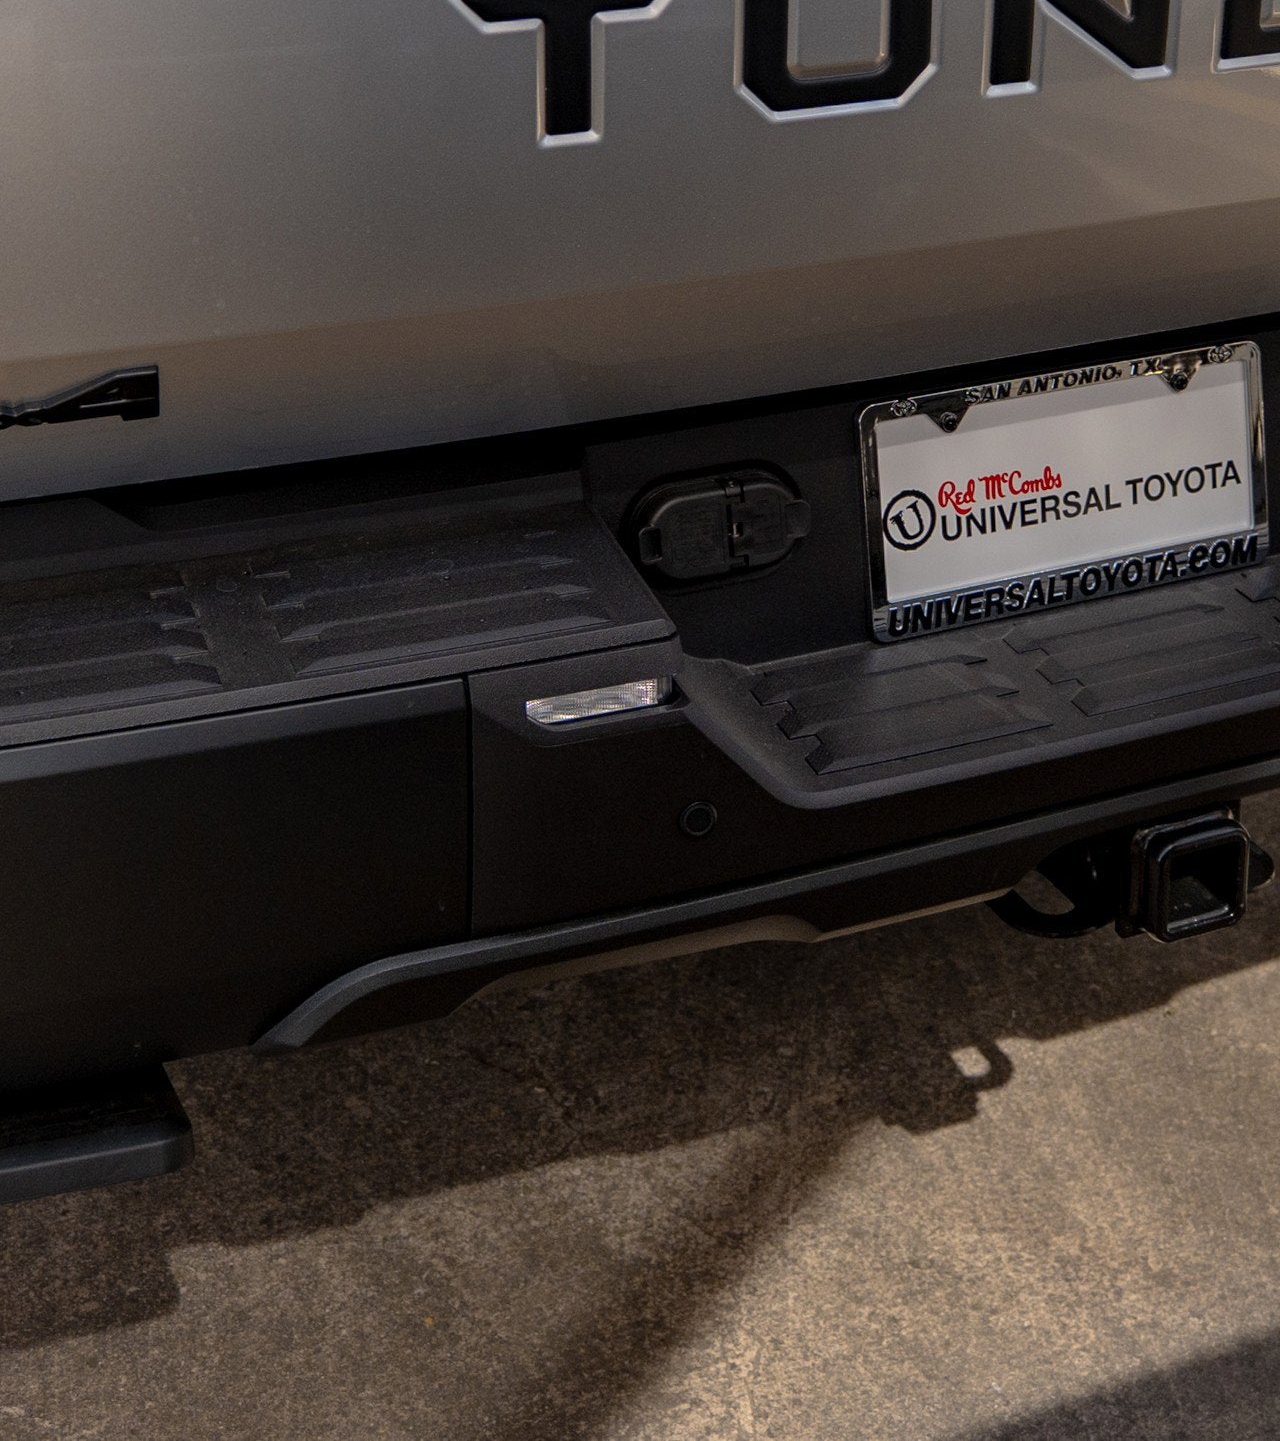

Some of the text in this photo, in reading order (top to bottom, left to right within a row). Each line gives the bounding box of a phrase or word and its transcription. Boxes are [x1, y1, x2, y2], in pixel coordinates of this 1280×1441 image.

[965, 383, 1012, 405] SAN
[938, 465, 1062, 516] Red McCombs
[940, 460, 1242, 542] UNIVERSAL TOYOTA
[887, 533, 1259, 638] UNIVERSALTOYOTA.COM
